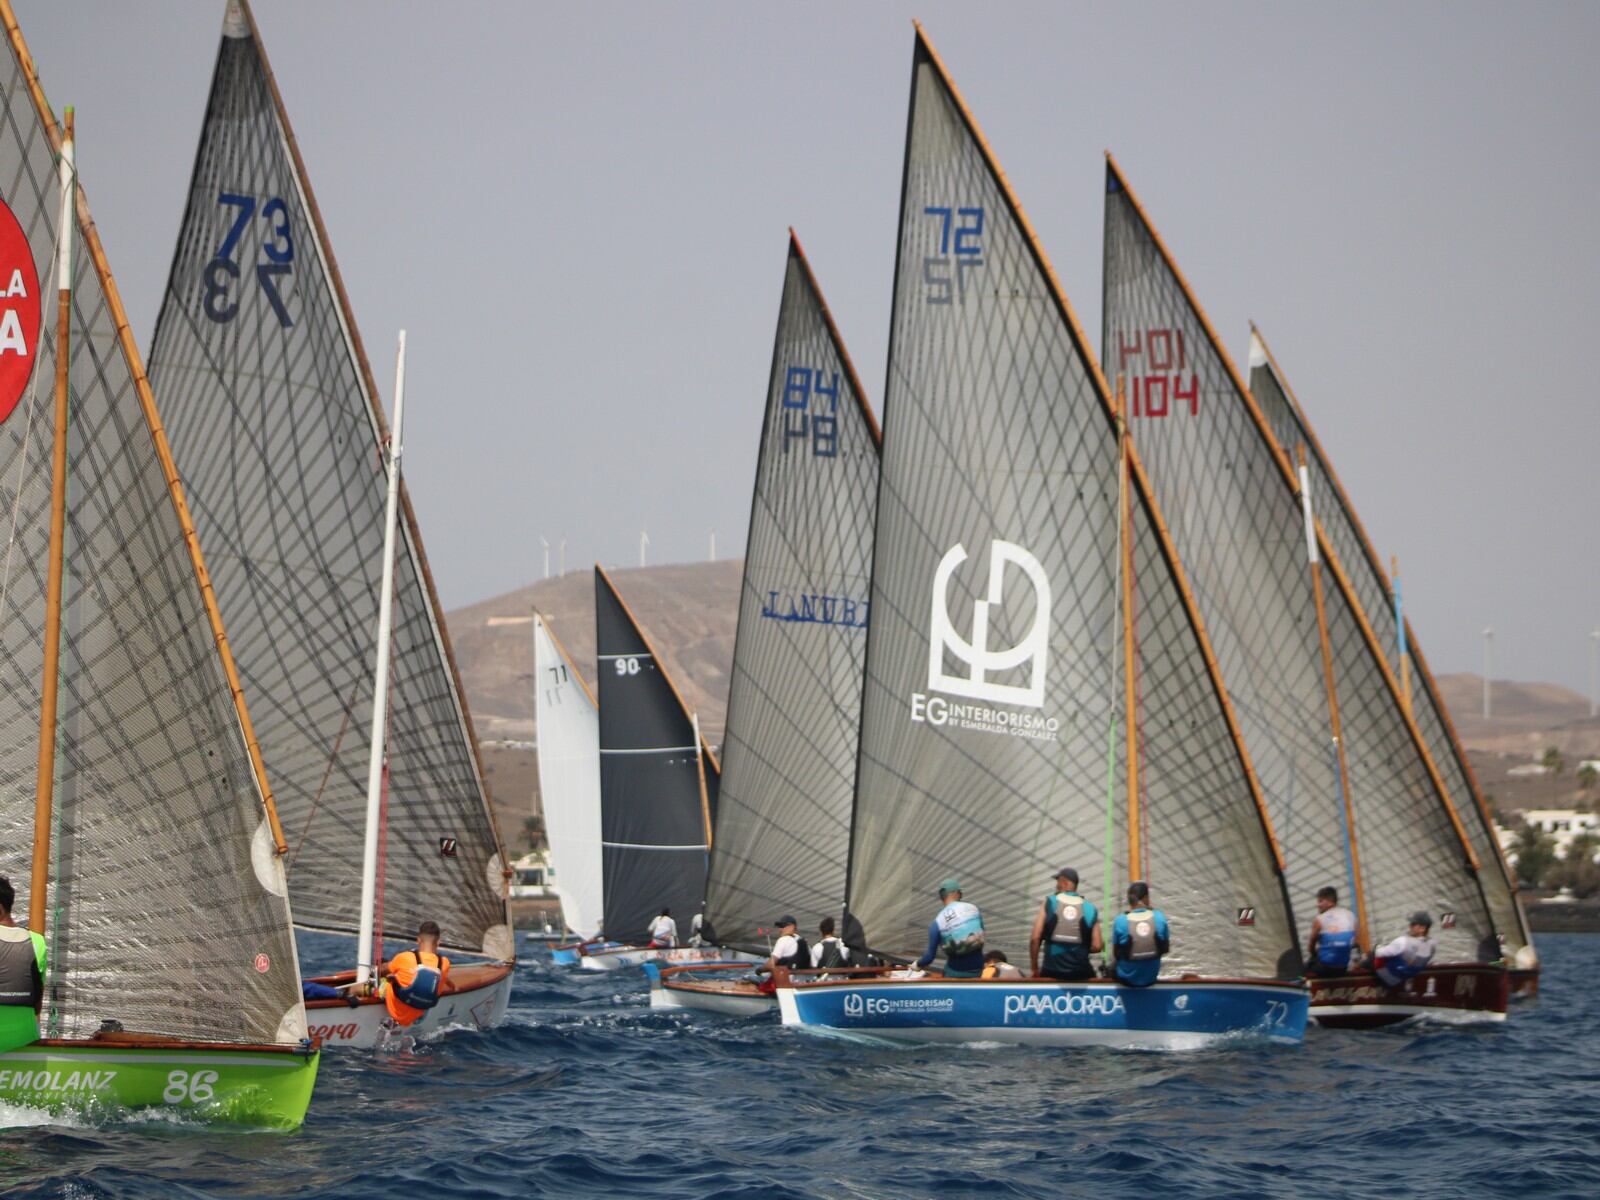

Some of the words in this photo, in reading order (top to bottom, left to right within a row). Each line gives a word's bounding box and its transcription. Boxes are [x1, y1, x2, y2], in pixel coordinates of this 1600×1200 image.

[217, 192, 295, 264] 73
[923, 206, 984, 254] 72
[0, 269, 27, 298] A
[783, 366, 840, 412] 84
[1132, 375, 1199, 417] 104
[548, 664, 568, 685] 71
[615, 657, 639, 676] 90
[911, 693, 949, 725] EG
[949, 703, 1059, 731] INTERIORISMO
[961, 720, 1008, 734] ESMERALDA
[866, 998, 890, 1013] EG
[890, 998, 954, 1008] INTERIORISMO
[162, 1069, 219, 1104] 86
